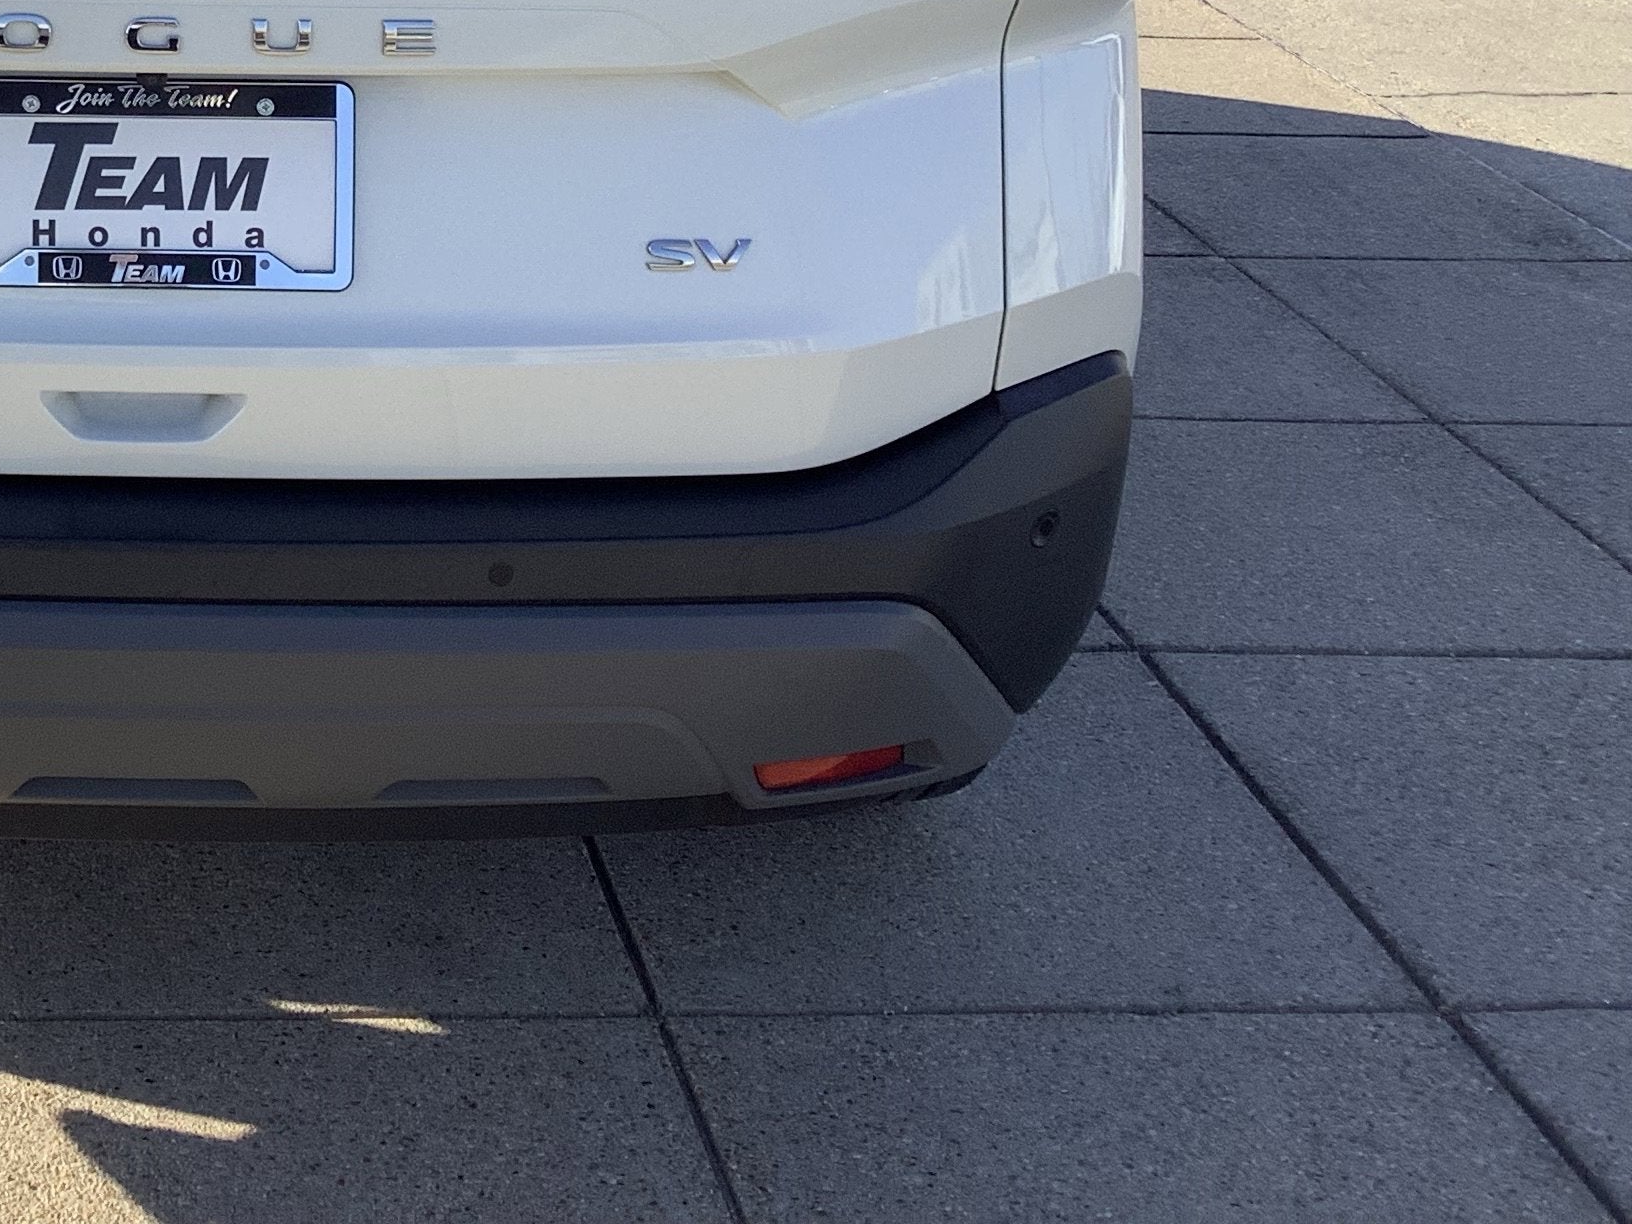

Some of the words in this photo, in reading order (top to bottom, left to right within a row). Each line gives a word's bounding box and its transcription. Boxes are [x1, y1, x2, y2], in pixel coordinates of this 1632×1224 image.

[55, 84, 115, 114] Join
[118, 84, 161, 108] The
[164, 85, 239, 109] Team!
[28, 122, 270, 211] TEAM
[32, 219, 265, 248] Honda
[109, 254, 185, 283] TEAM
[646, 239, 752, 271] SV
